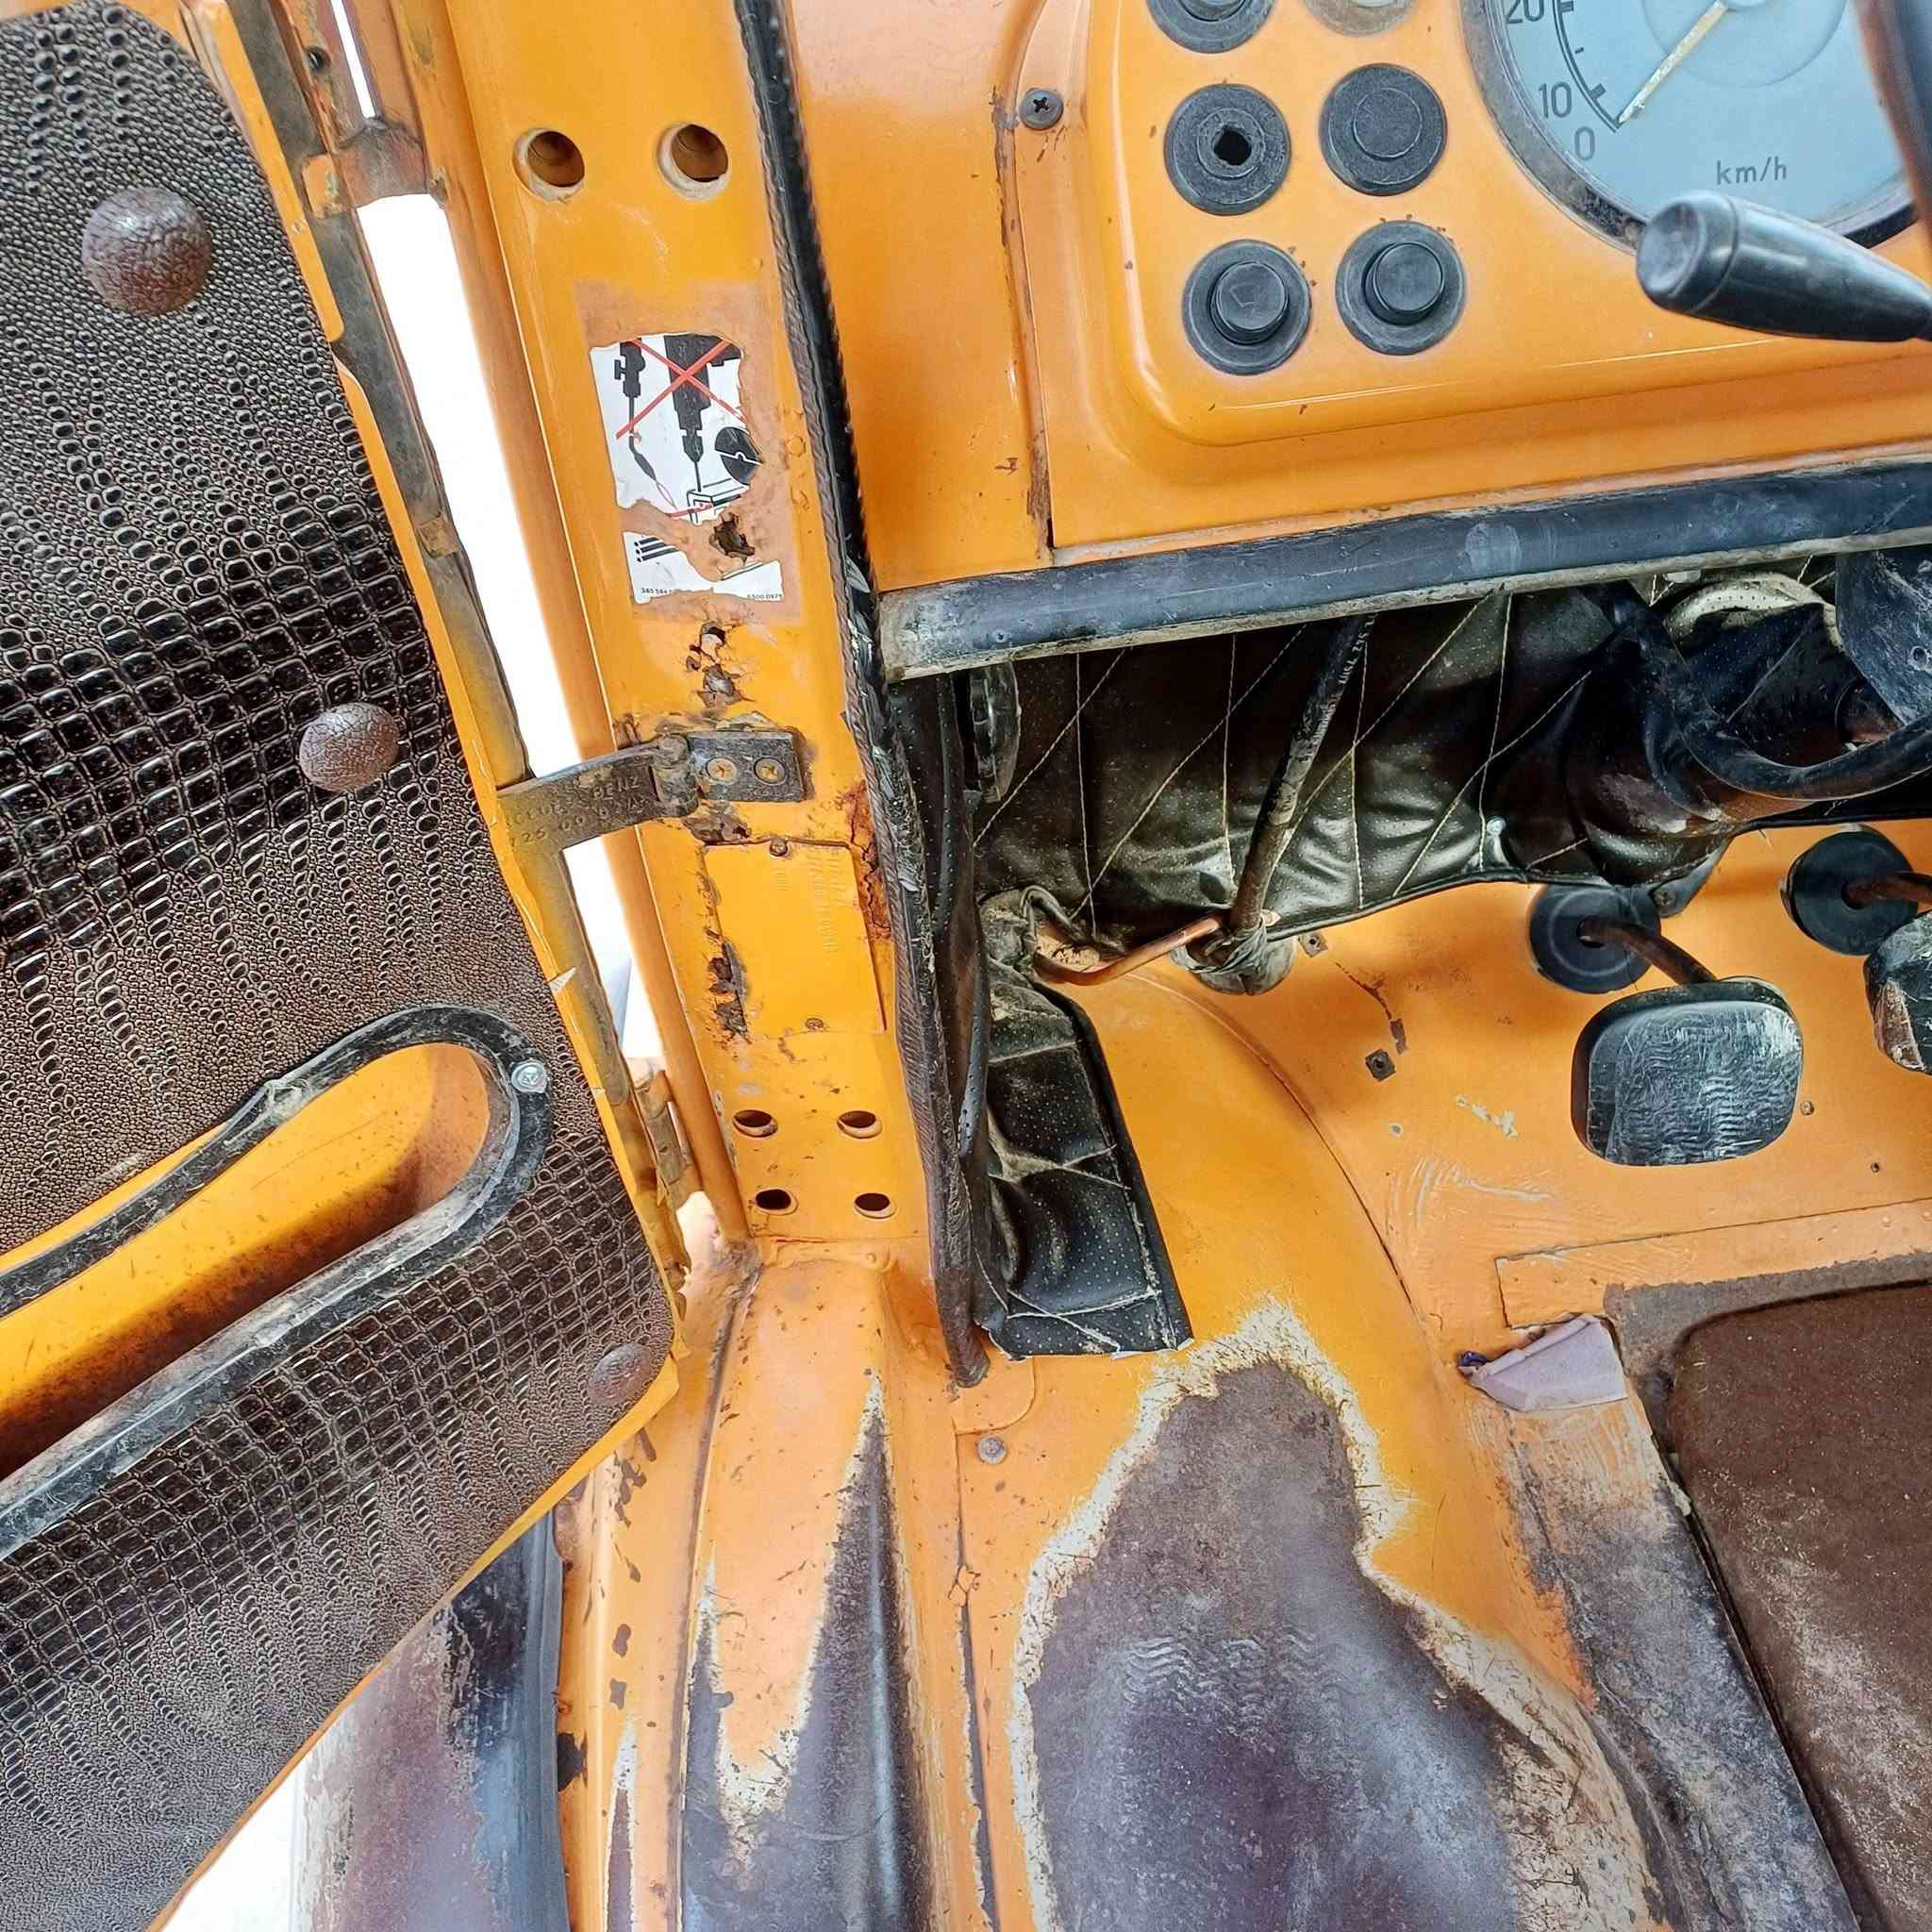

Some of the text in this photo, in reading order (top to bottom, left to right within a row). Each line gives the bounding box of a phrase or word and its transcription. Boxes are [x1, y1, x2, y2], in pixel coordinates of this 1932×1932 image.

[1507, 0, 1545, 24] 20
[1538, 82, 1573, 119] 10
[1574, 125, 1596, 161] 0
[1716, 157, 1788, 186] km/h
